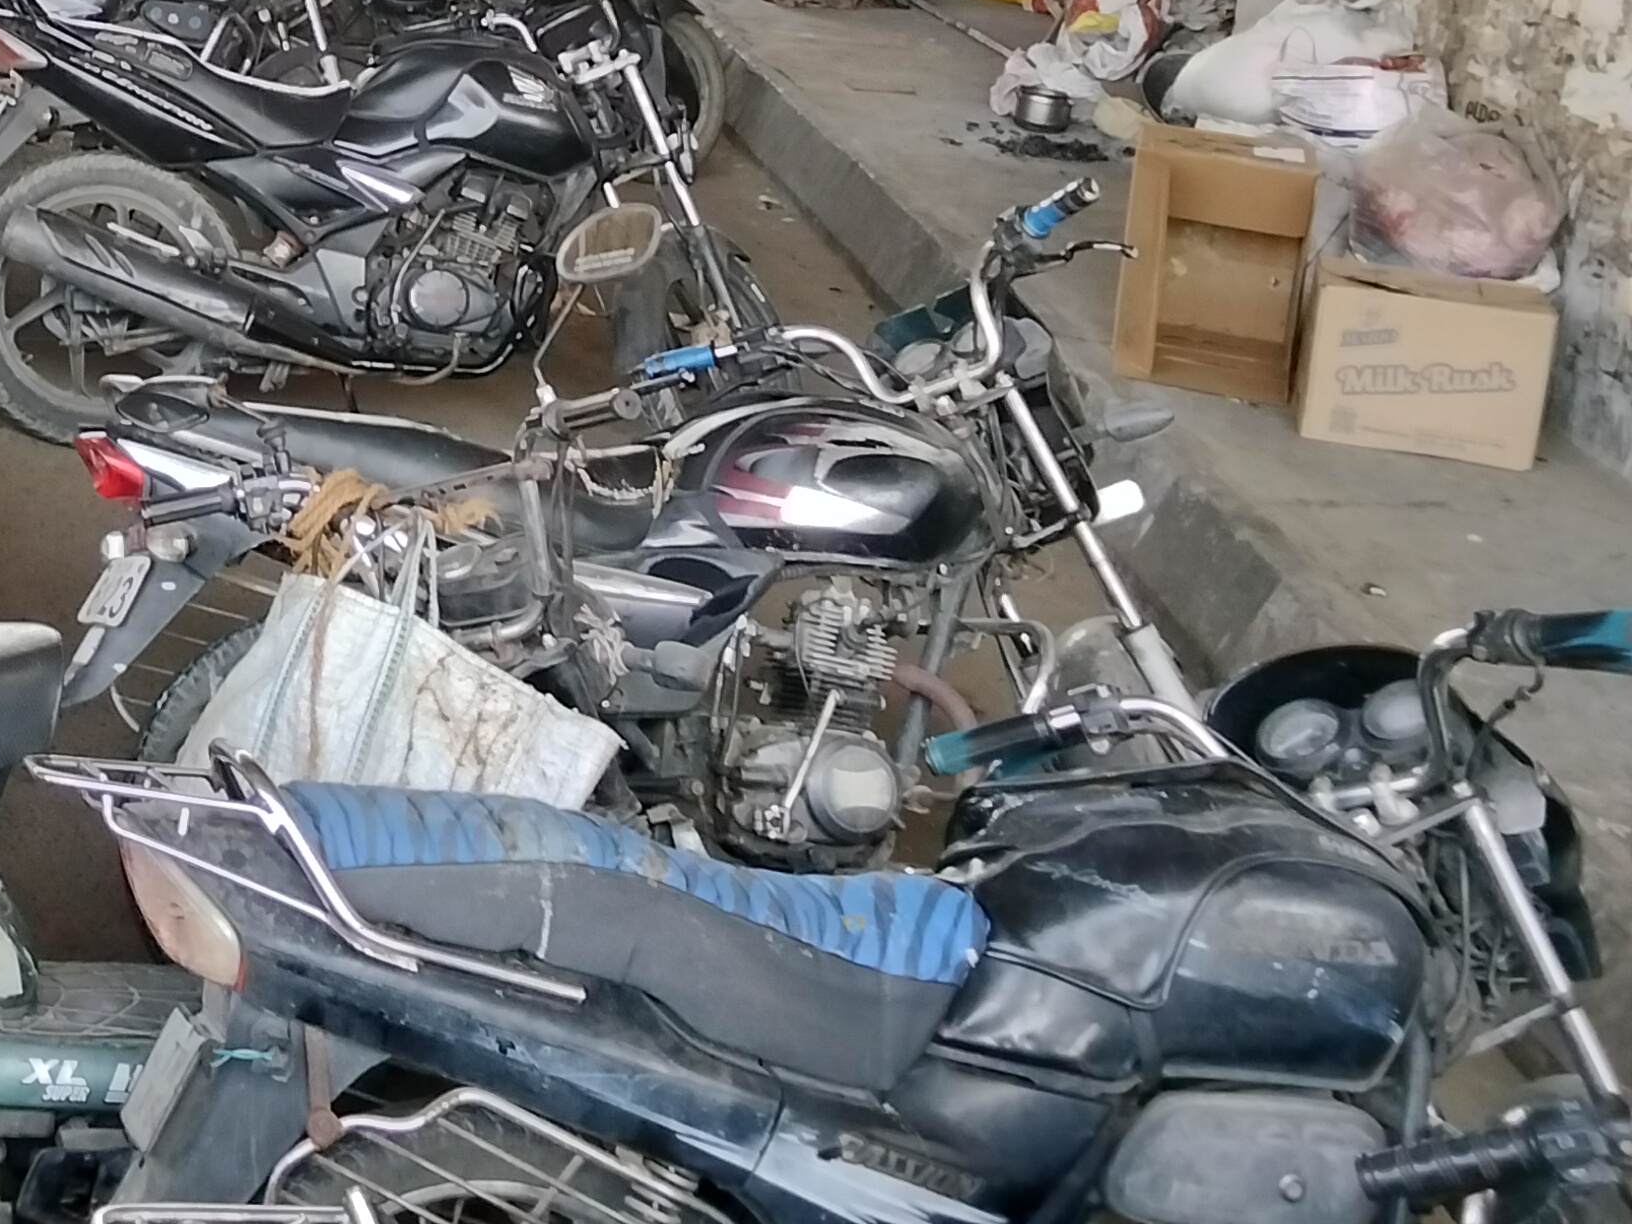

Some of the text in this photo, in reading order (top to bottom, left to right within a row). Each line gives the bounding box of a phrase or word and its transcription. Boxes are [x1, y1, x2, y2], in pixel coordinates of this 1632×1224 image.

[1334, 361, 1517, 396] Milk Rusk
[21, 1057, 87, 1086] XL
[41, 1084, 91, 1103] SUPER
